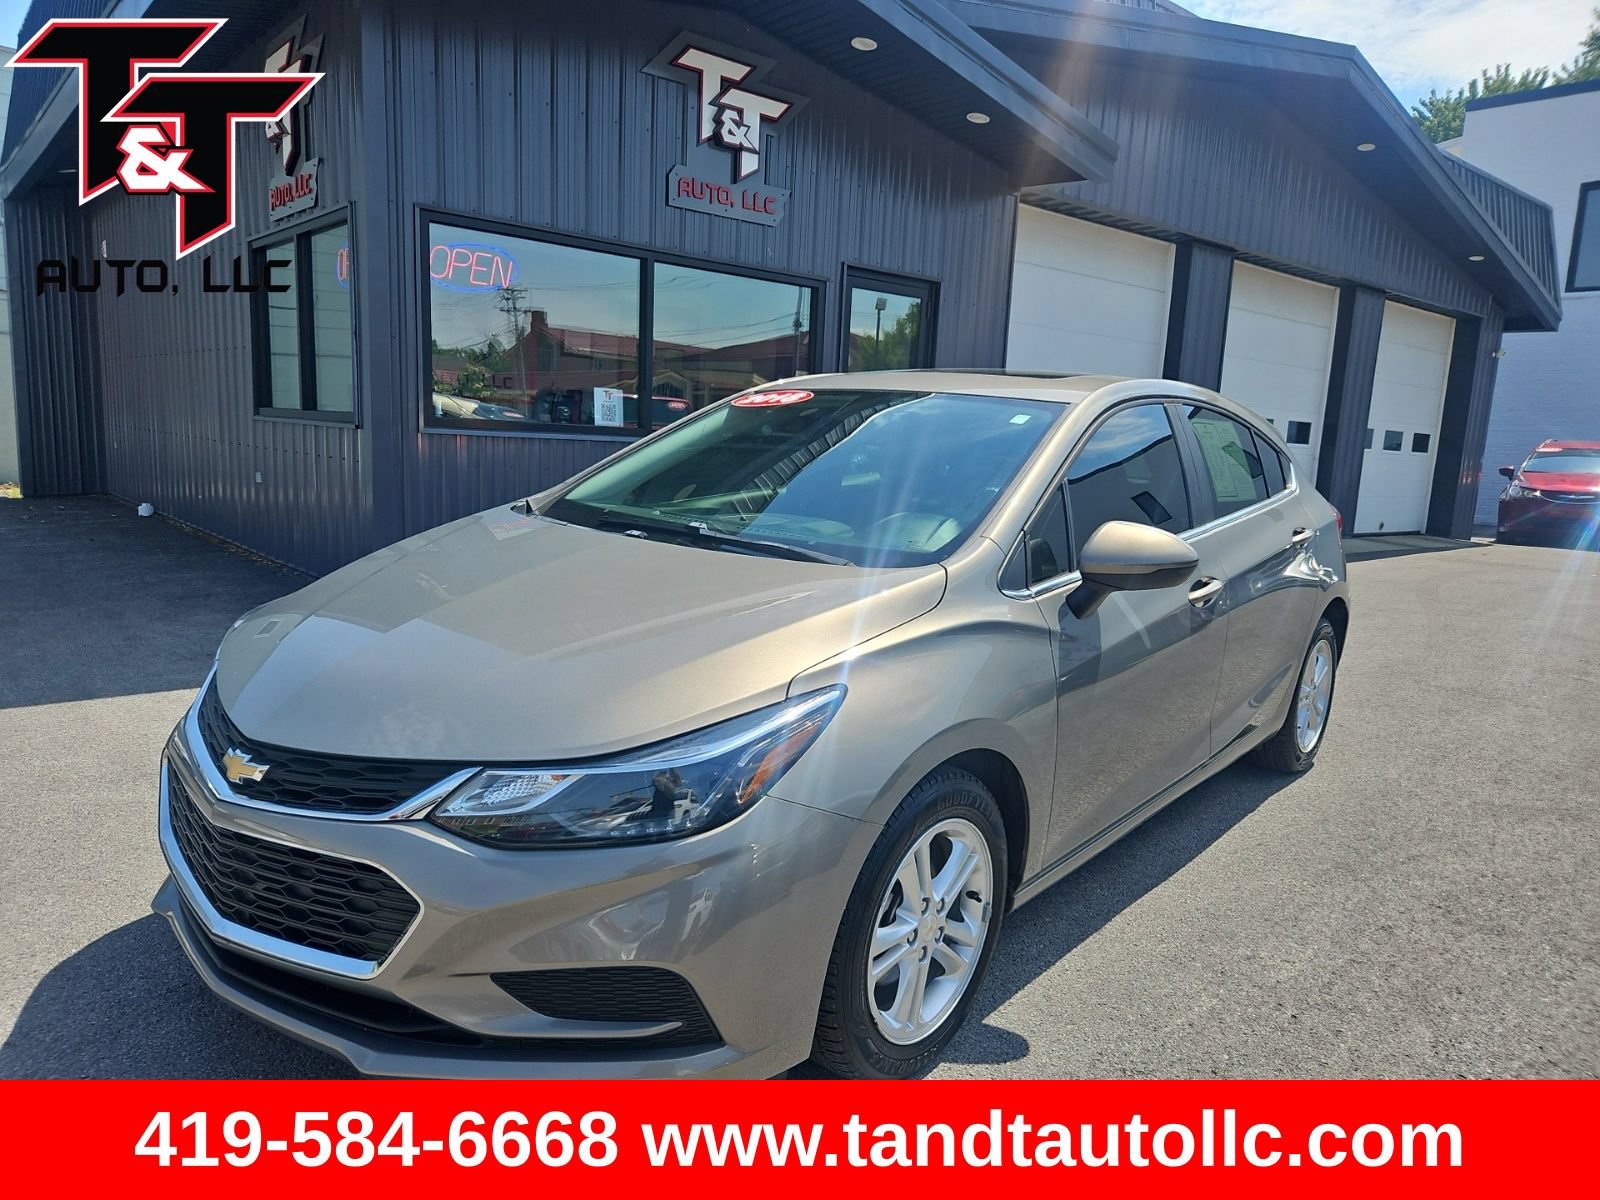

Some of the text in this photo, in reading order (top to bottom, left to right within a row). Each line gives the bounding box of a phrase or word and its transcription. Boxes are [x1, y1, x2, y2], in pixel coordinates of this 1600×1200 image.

[671, 45, 794, 183] T&T
[294, 173, 313, 198] LLC
[741, 189, 778, 214] LLC
[430, 245, 513, 288] OPEN
